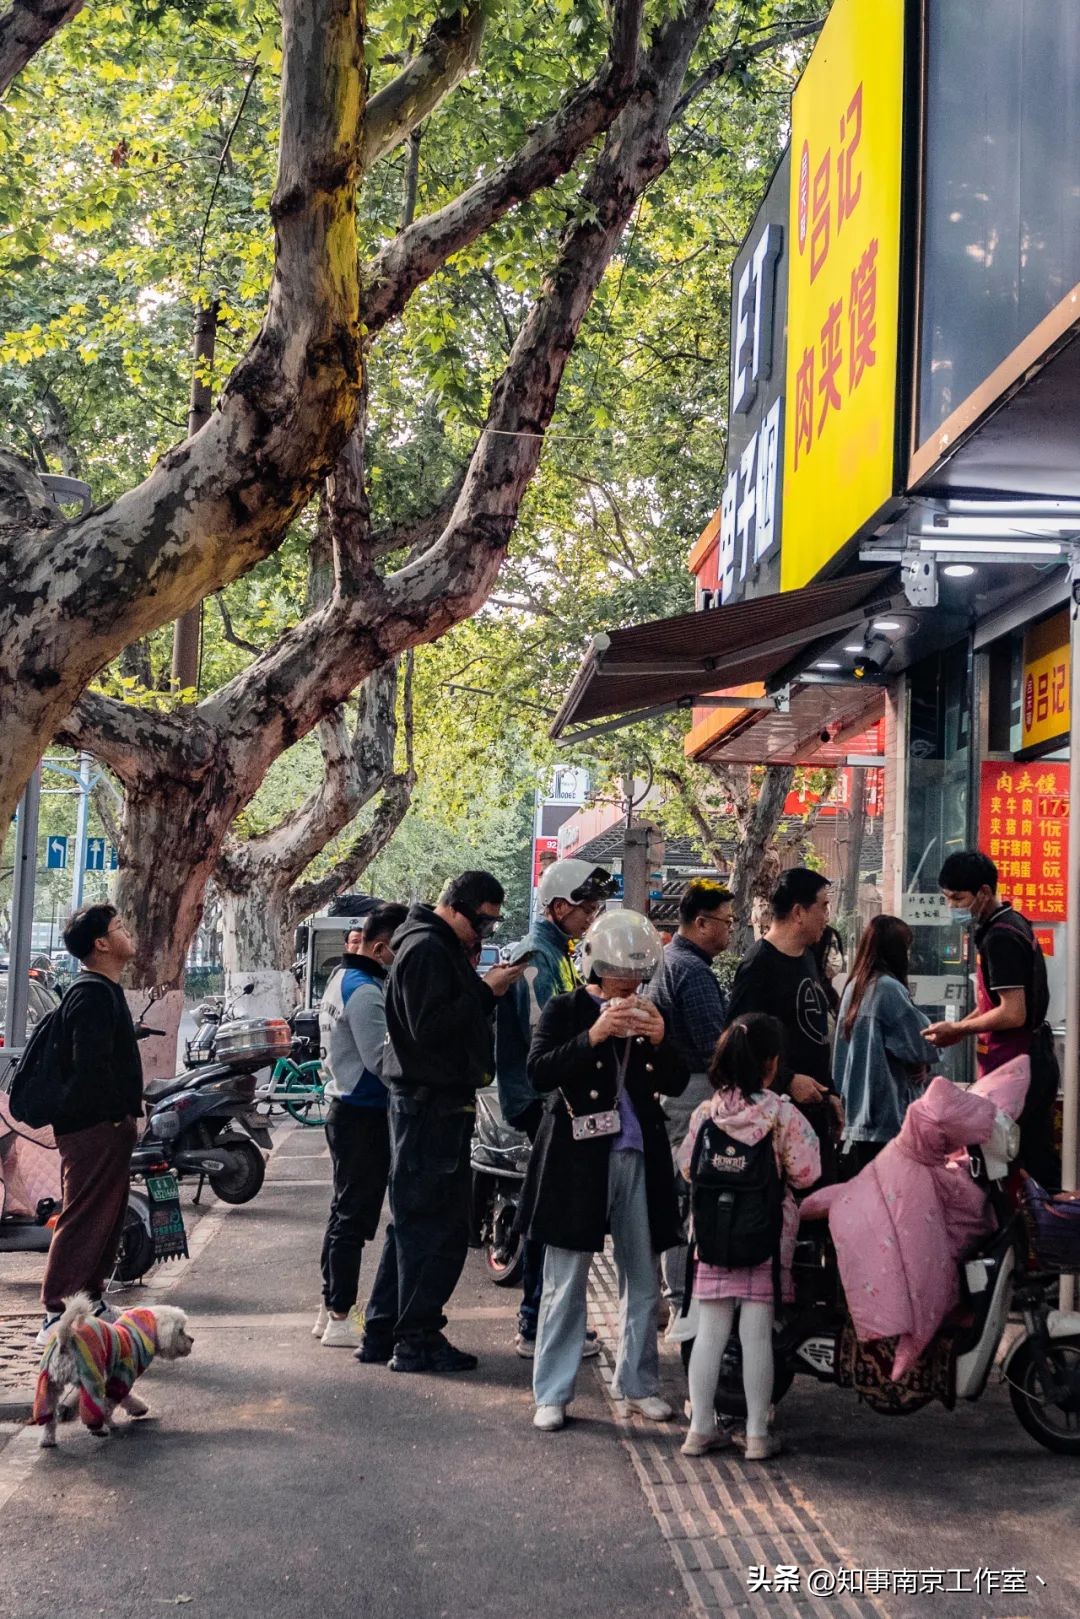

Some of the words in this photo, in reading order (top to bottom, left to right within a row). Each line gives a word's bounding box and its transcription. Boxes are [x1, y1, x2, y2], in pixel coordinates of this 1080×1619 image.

[810, 80, 863, 285] 吕记
[733, 224, 781, 414] ET
[794, 237, 879, 472] 肉夹馍
[718, 396, 781, 605] 电子烟
[1037, 664, 1065, 722] 吕记
[996, 771, 1057, 794] 肉夹馍
[991, 797, 1033, 815] 夹牛肉
[990, 818, 1033, 836] 夹猪肉
[1039, 819, 1061, 837] 11元
[546, 841, 557, 849] 92
[1043, 840, 1061, 858] 9元
[1042, 861, 1061, 878] 6元
[1038, 883, 1064, 896] 1.5元
[1038, 900, 1064, 913] 1.5元
